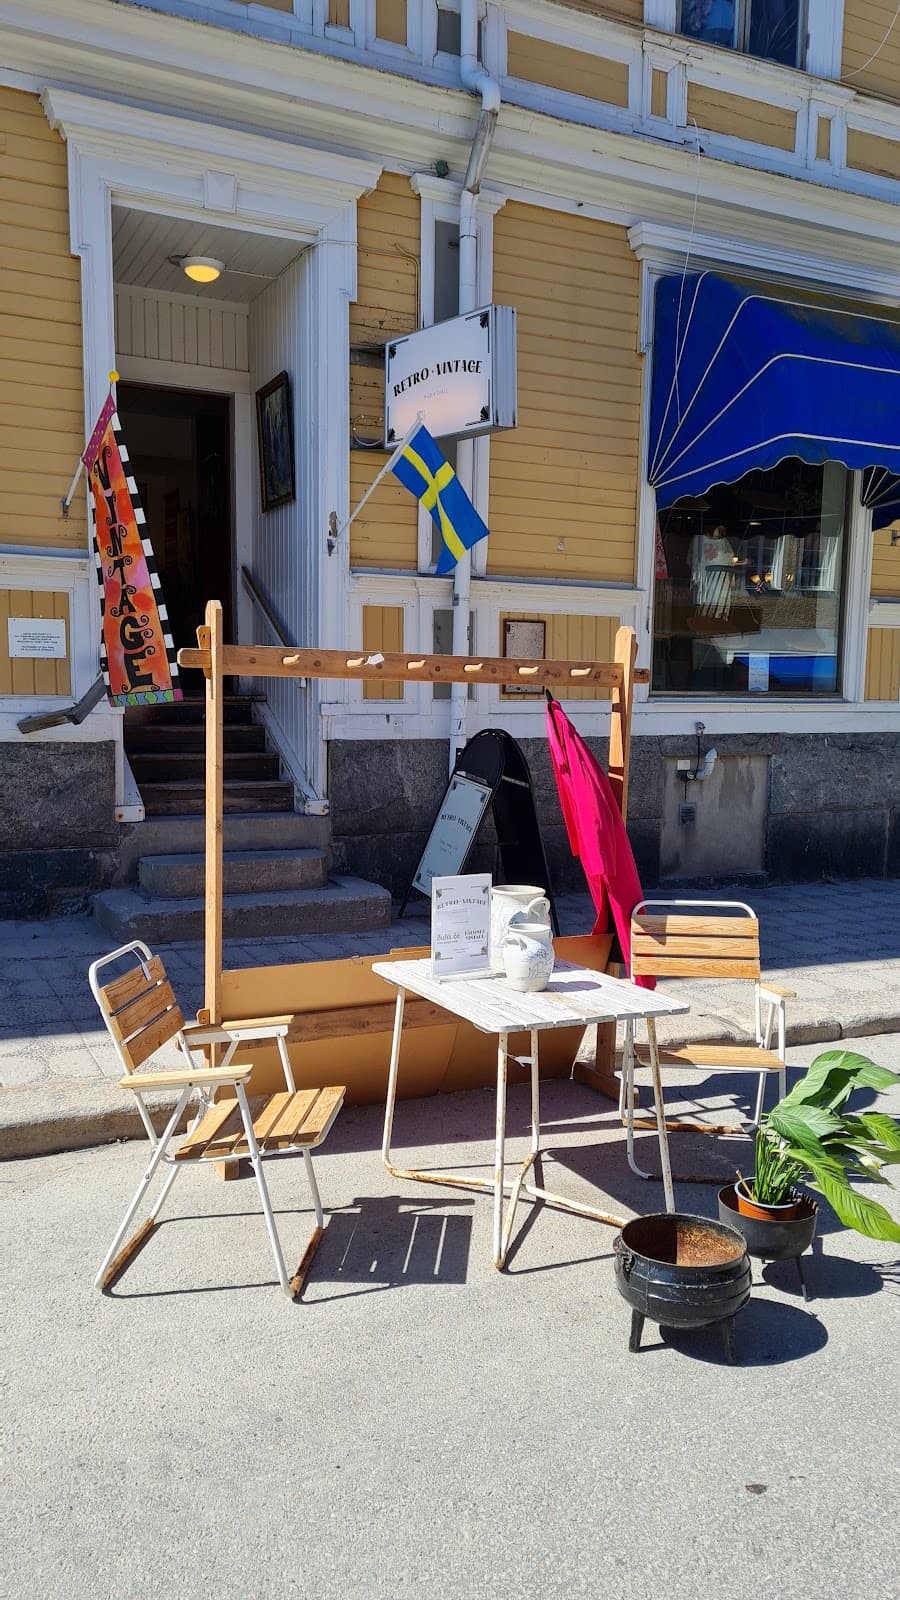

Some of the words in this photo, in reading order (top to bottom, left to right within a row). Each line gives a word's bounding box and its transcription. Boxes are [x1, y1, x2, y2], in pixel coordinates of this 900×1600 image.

[393, 367, 430, 397] RETRO
[435, 359, 483, 376] VINTAGE
[94, 445, 159, 692] VINTAGE
